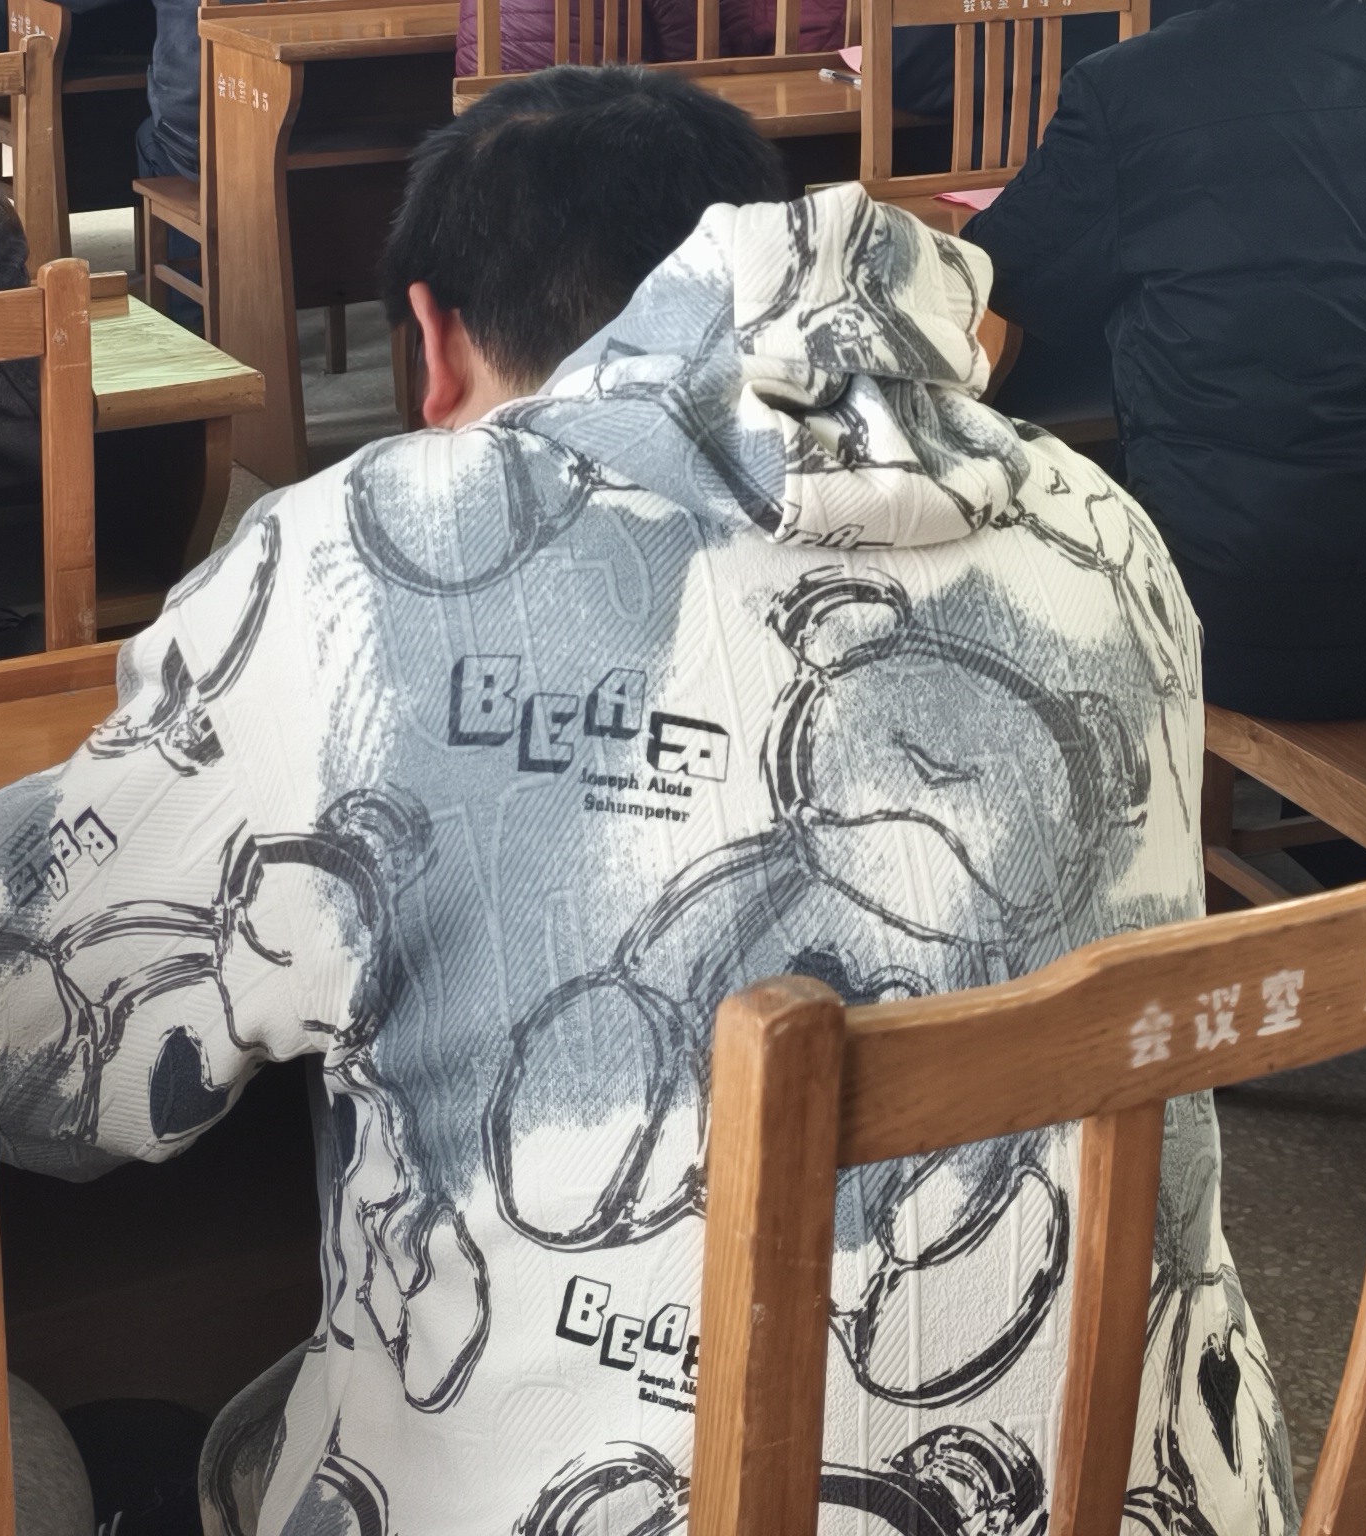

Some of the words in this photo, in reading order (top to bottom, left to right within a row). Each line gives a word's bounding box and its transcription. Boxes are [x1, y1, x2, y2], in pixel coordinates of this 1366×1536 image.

[580, 768, 639, 791] Joseph
[1128, 968, 1305, 1069] 会议室
